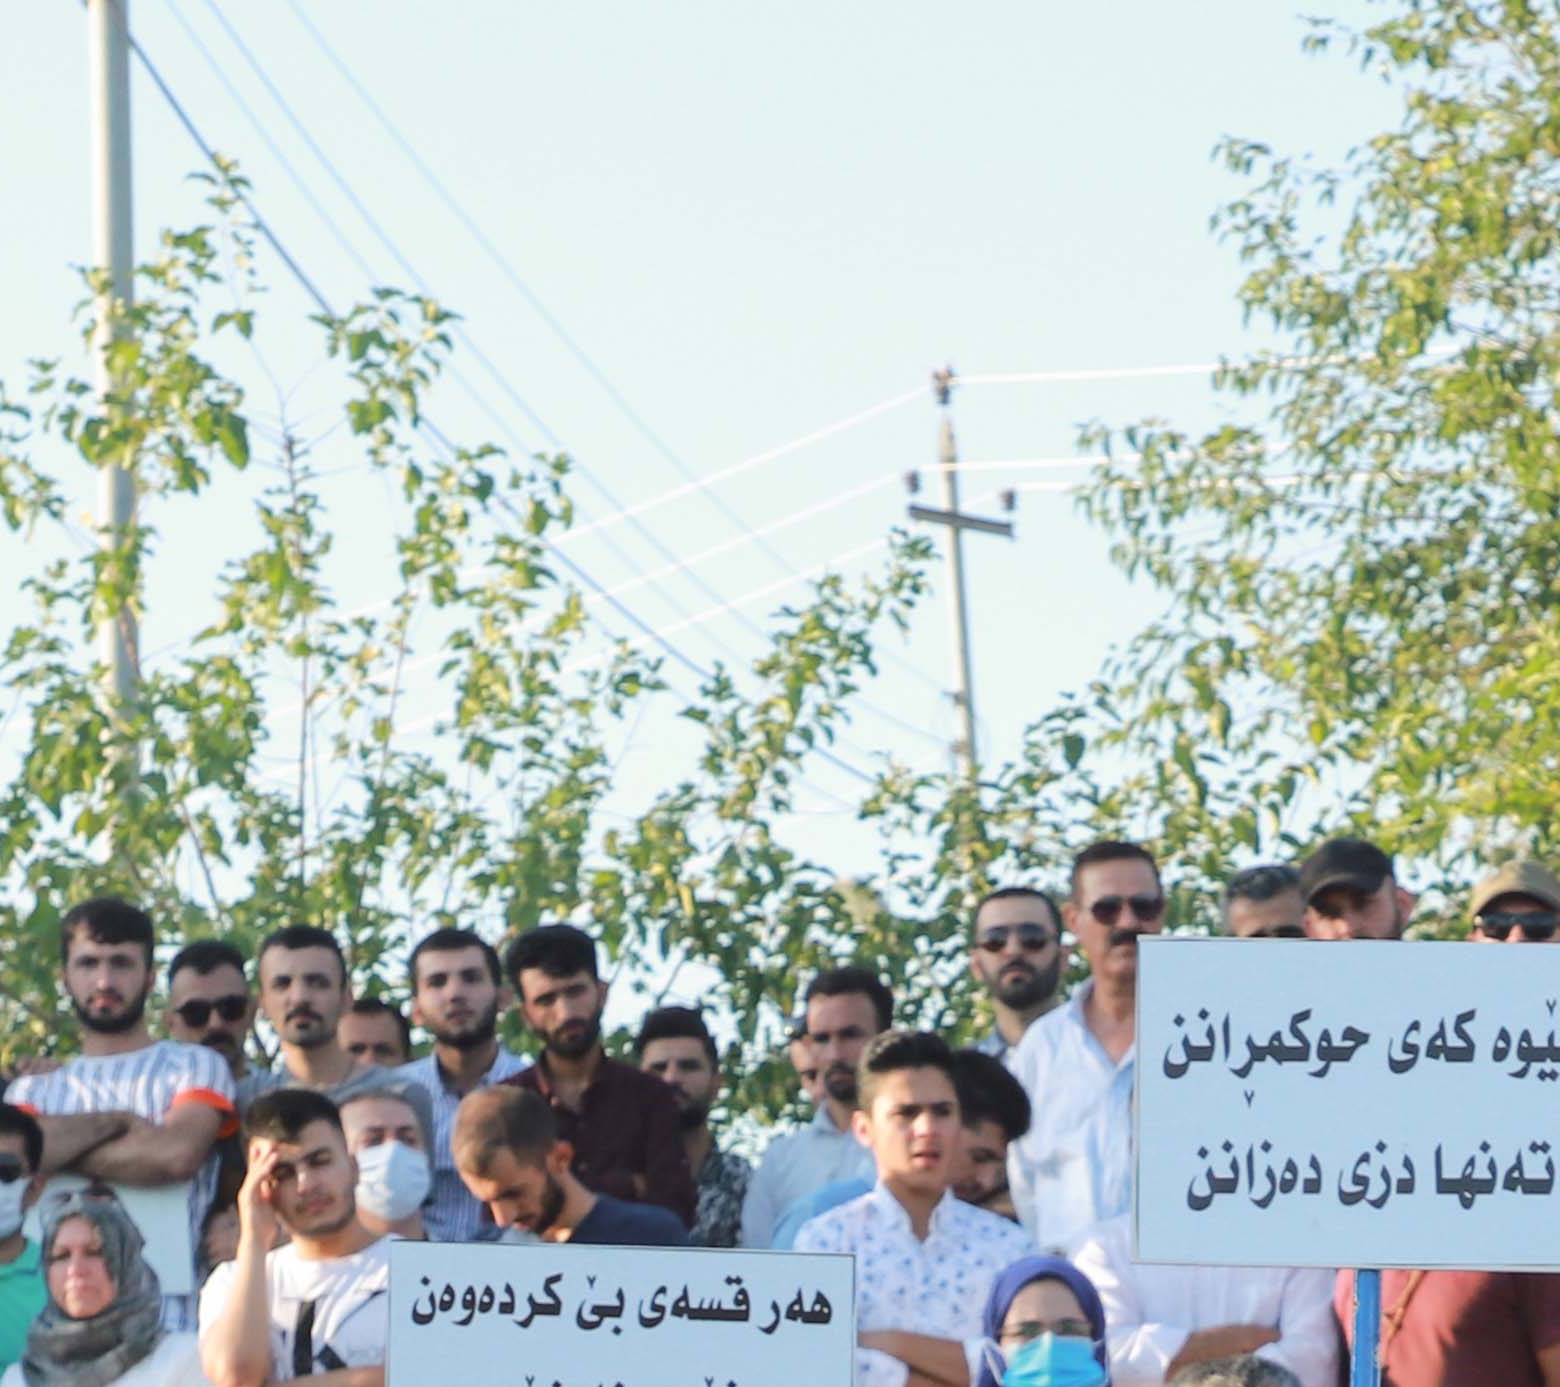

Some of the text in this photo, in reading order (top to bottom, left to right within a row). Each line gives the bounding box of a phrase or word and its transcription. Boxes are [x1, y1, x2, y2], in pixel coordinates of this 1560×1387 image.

[1387, 1009, 1477, 1075] کەی
[1186, 1139, 1556, 1212] تەنها دزی دەزانن
[411, 1273, 833, 1336] هەر قسەی بێ کردەوەن
